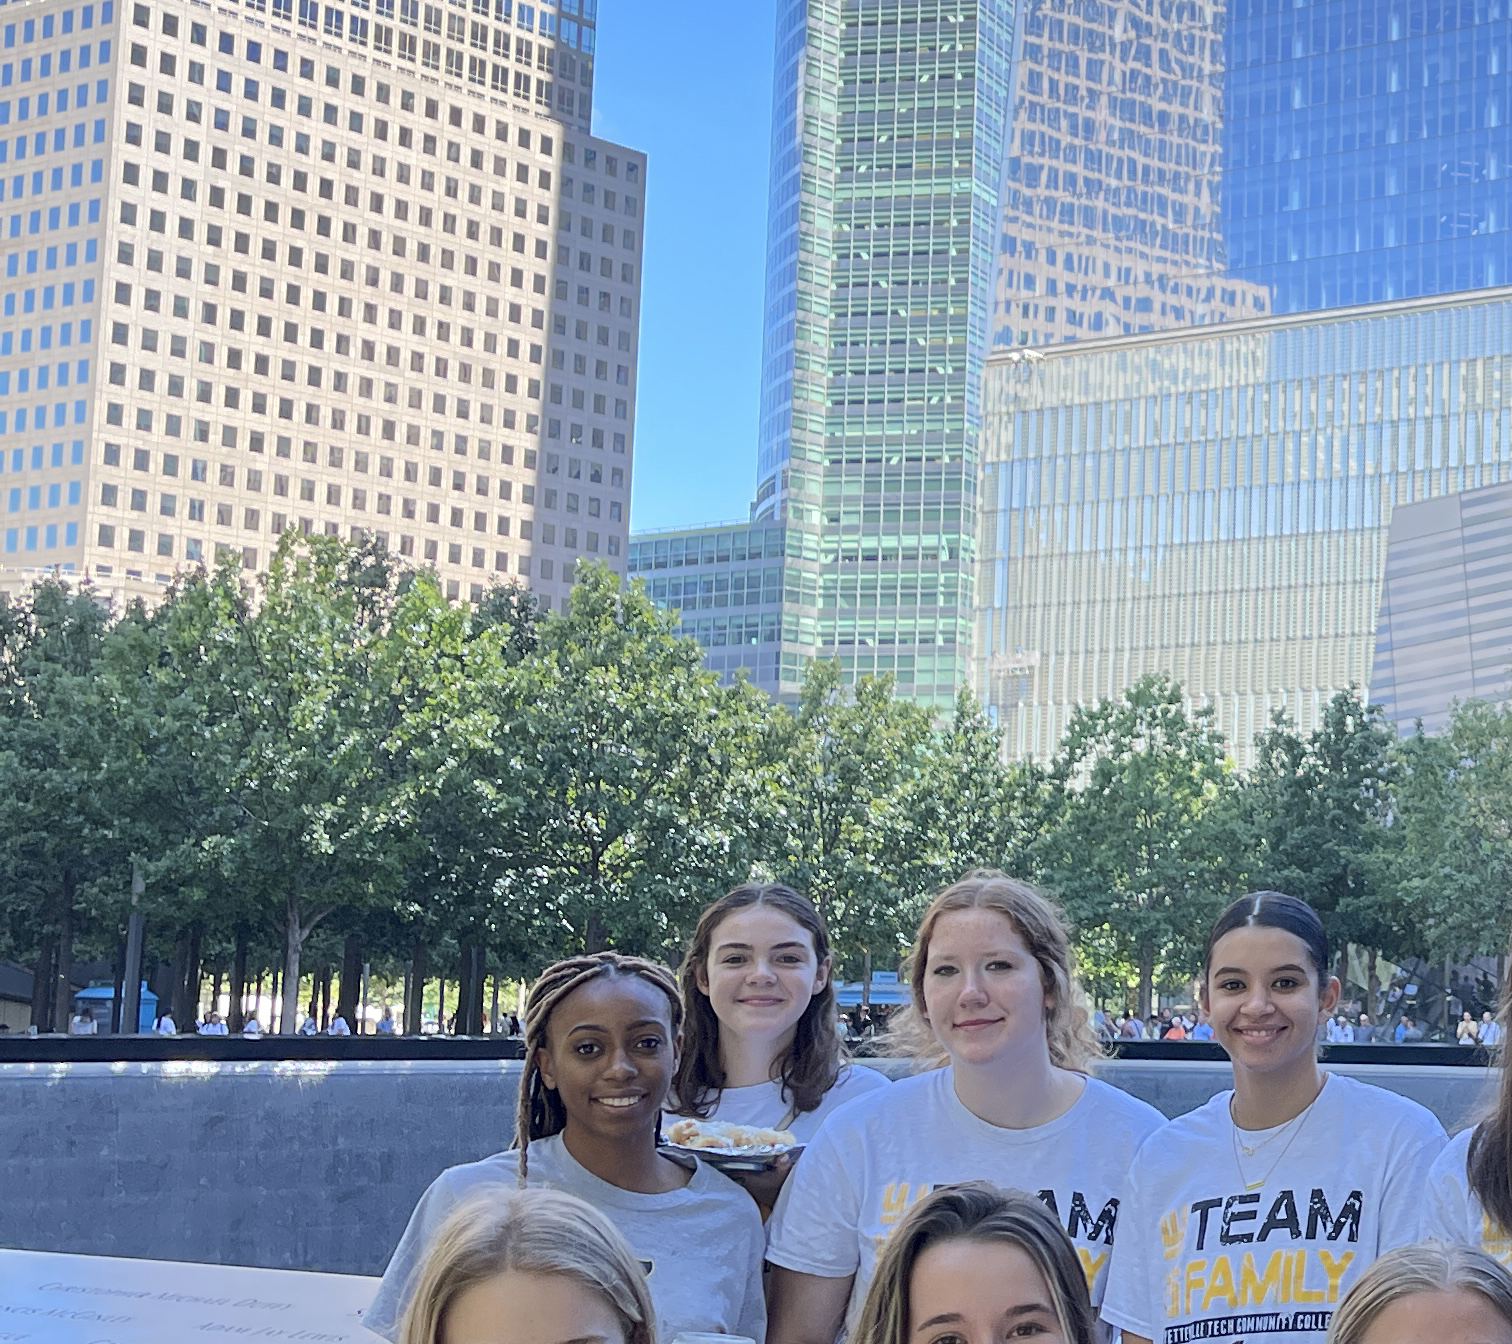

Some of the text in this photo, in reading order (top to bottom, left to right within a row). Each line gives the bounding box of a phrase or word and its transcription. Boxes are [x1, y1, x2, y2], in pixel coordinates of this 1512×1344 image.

[1191, 1188, 1364, 1250] TEAM
[1185, 1249, 1356, 1316] FAMILY
[1207, 1320, 1234, 1335] TECH
[1236, 1314, 1294, 1332] COMMUNITY
[1297, 1312, 1331, 1330] COLLE
